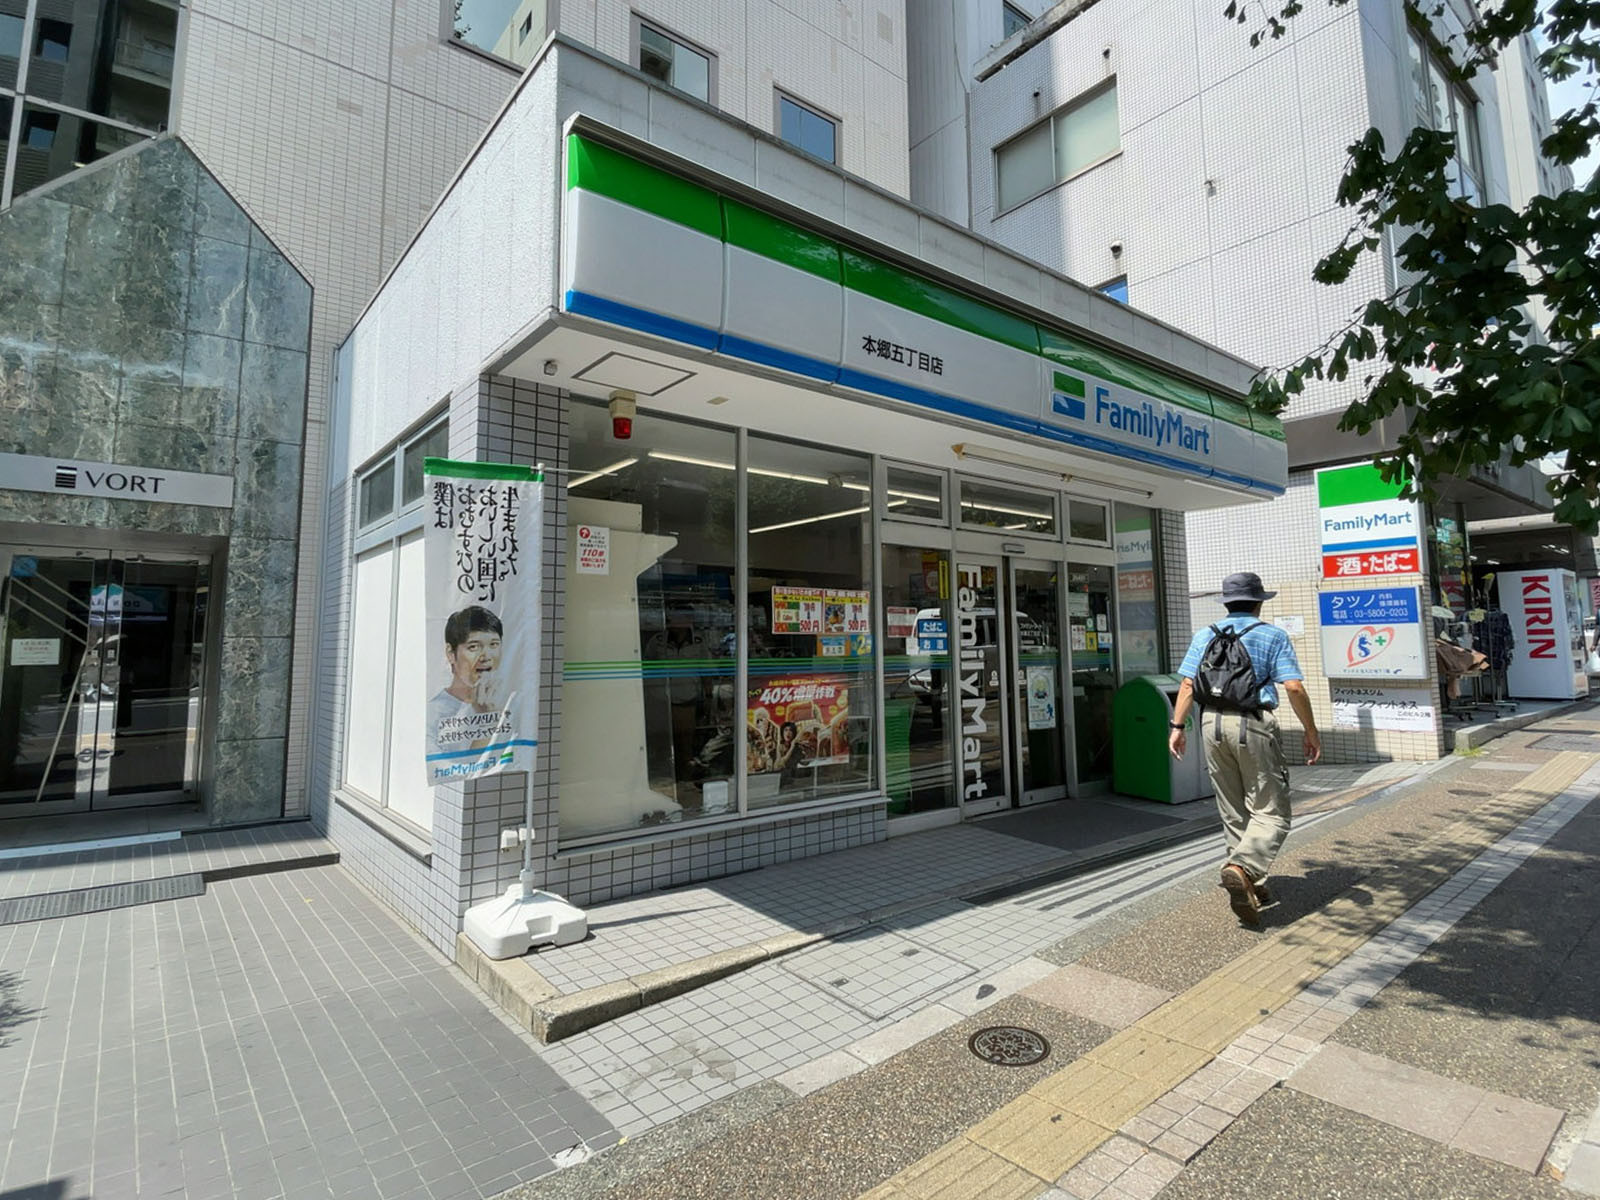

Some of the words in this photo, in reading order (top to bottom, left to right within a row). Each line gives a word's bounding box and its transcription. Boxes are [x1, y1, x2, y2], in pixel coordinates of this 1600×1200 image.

[862, 335, 943, 376] 本郷五丁目店
[1096, 386, 1211, 455] FamilyMart
[85, 470, 165, 494] VORT
[1324, 511, 1412, 532] FamilyMart
[1336, 552, 1413, 575] 酒・たばこ
[1331, 594, 1375, 609] タツノ
[923, 622, 943, 632] たばこ
[1521, 575, 1557, 659] KIRIN
[957, 564, 988, 800] FamilyMart
